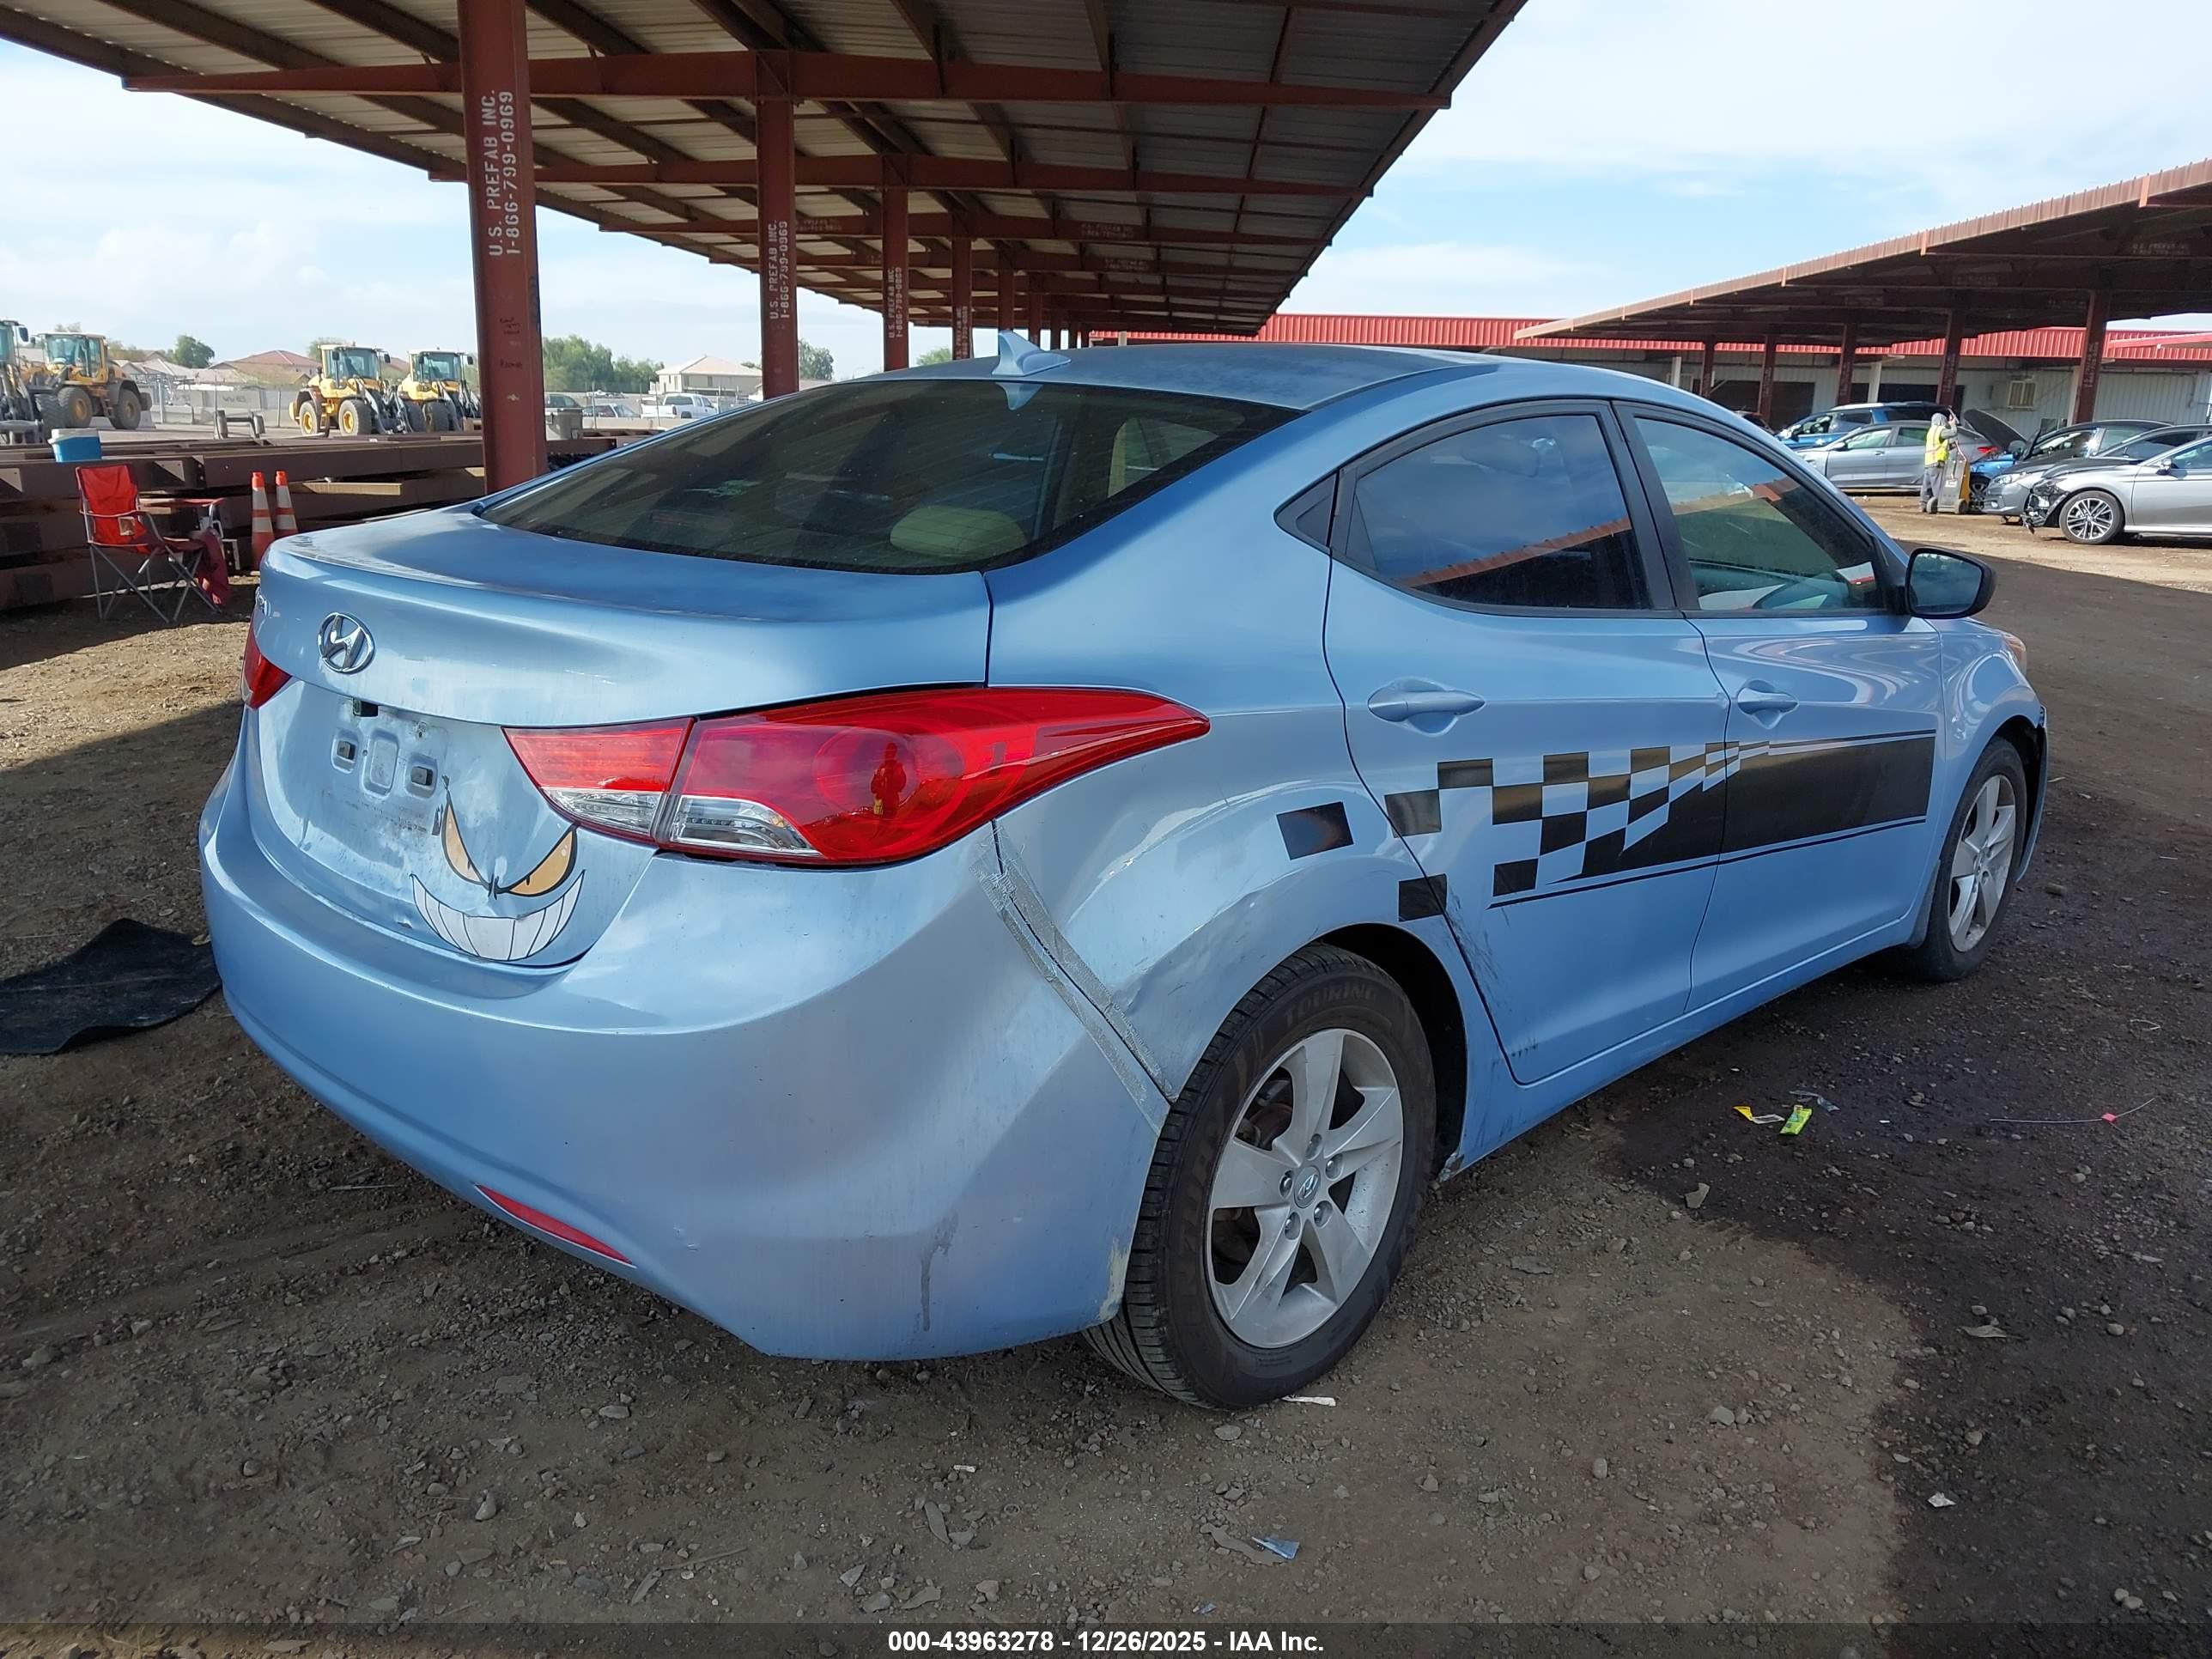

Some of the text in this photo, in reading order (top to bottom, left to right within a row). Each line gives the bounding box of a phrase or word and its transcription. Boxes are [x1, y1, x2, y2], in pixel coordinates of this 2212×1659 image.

[481, 89, 504, 256] U.S. PREFAB INC.
[498, 91, 521, 254] 1-866-799-0969
[767, 219, 781, 319] U.S. PREFAB INC.
[778, 220, 791, 319] 1-866-799-0969
